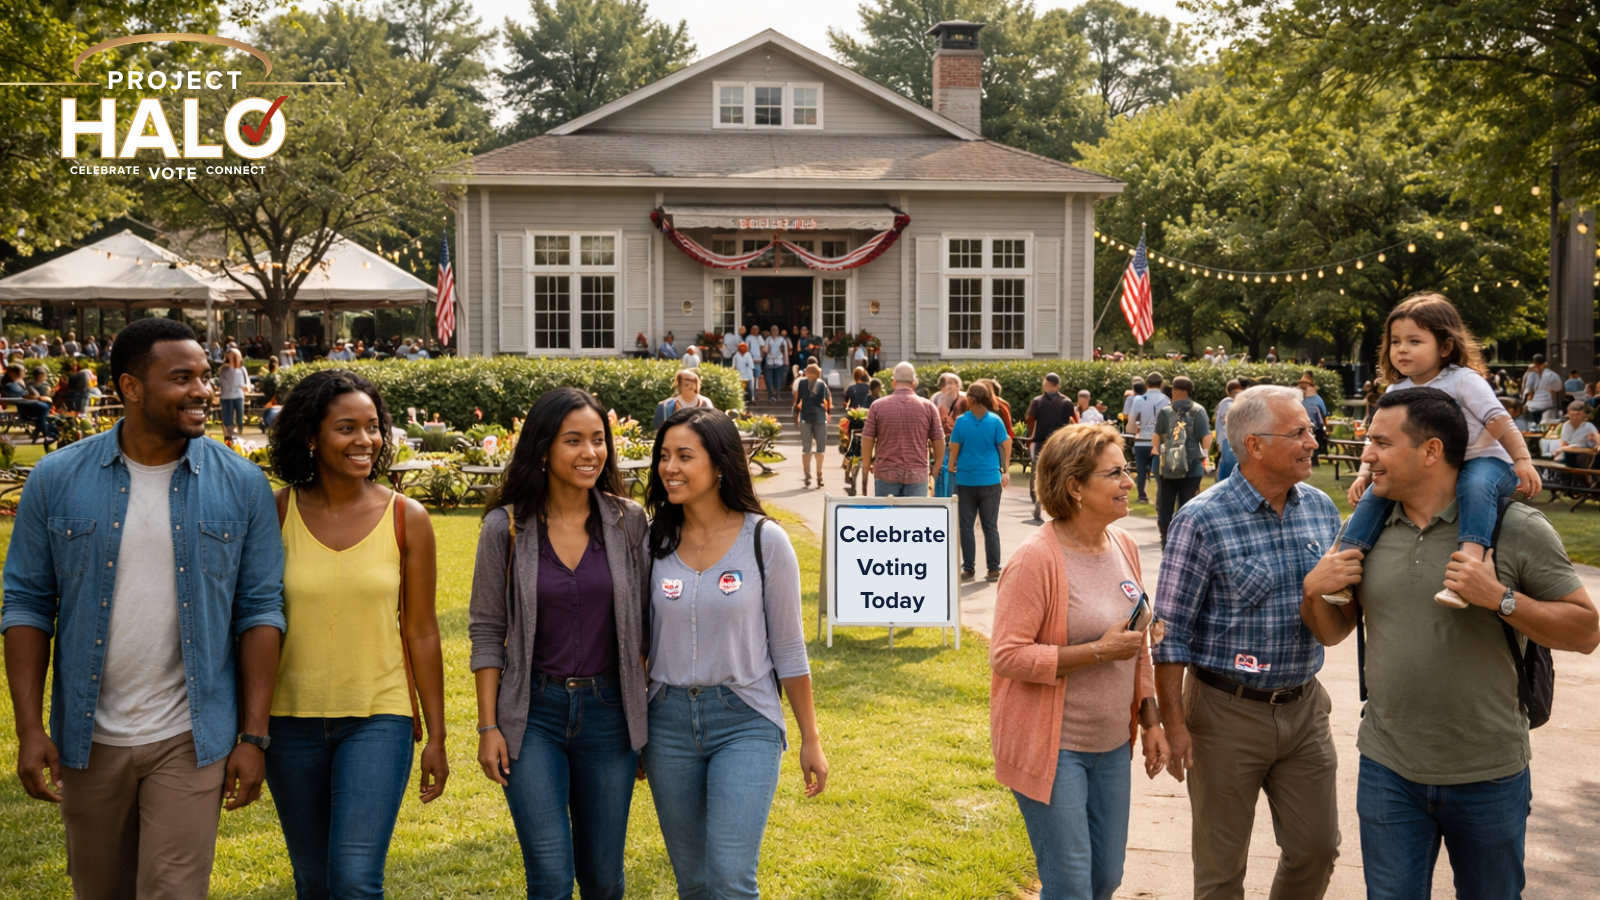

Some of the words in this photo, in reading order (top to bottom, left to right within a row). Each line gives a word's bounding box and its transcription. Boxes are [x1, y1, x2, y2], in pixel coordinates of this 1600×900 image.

[839, 525, 946, 543] Celebrate
[856, 558, 928, 580] Voting
[860, 591, 926, 613] Today
